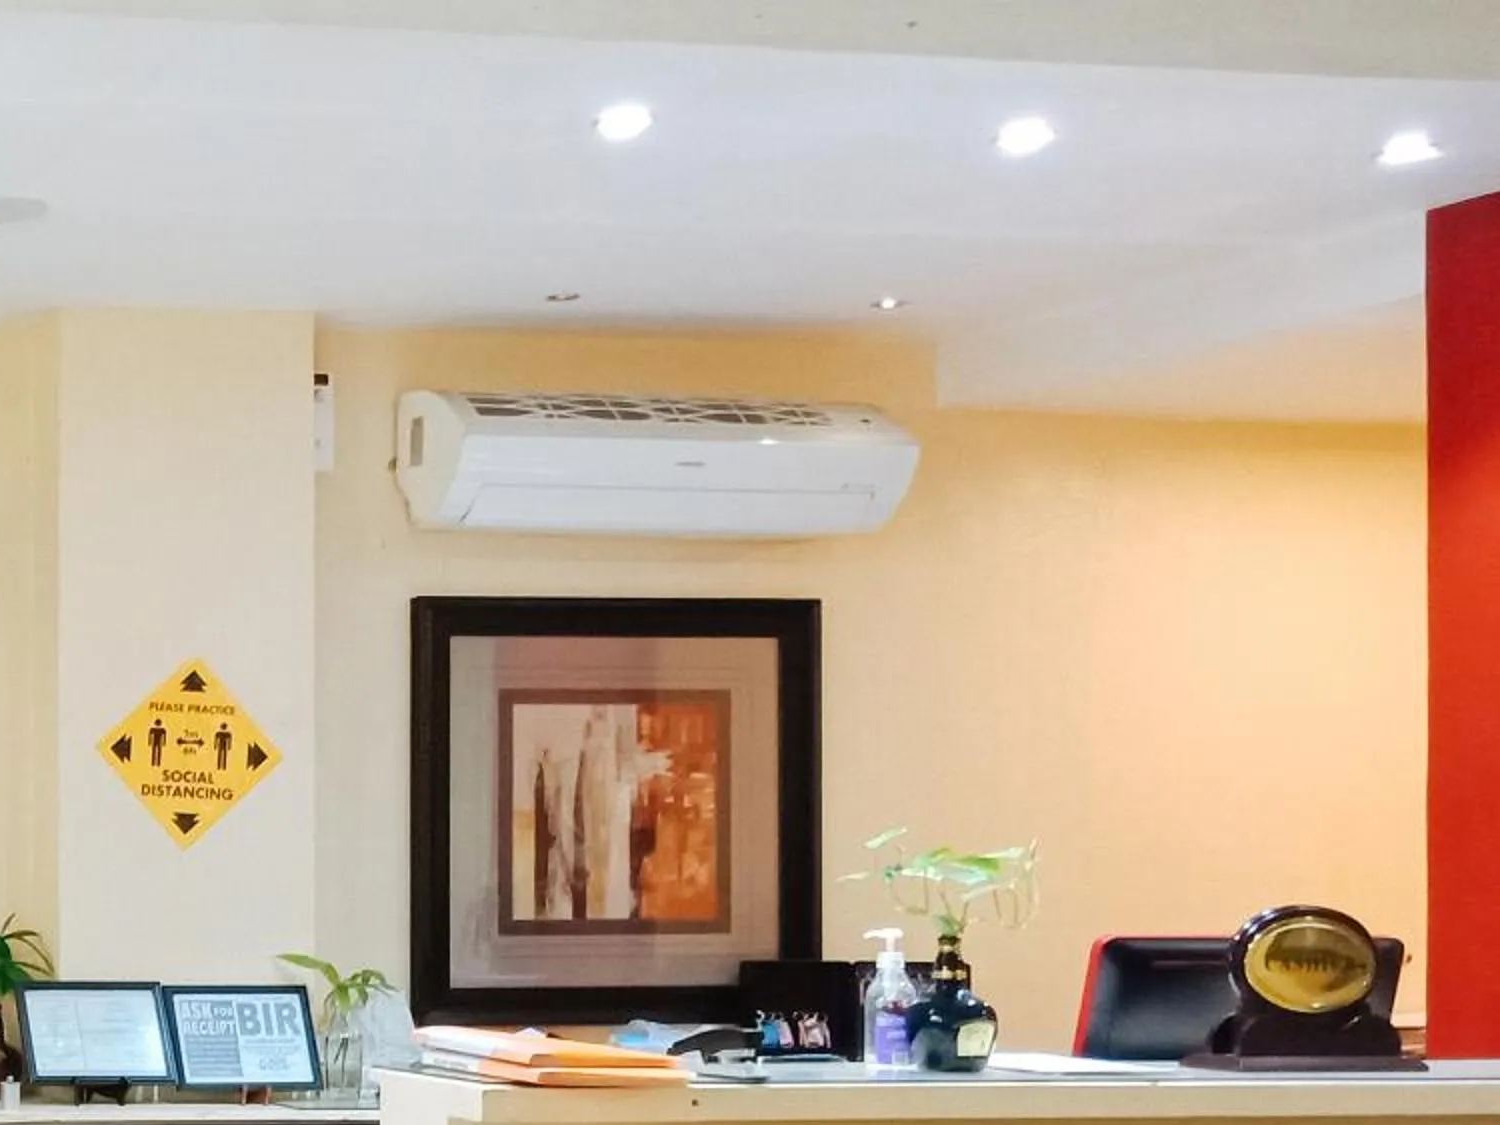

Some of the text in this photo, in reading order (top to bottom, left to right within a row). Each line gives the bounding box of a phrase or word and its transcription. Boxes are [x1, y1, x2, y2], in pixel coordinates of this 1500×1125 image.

[149, 702, 235, 715] PLEASE PRACTICE
[162, 769, 214, 784] SOCIAL
[141, 784, 234, 801] DISTANCING
[181, 1001, 213, 1019] ASK
[236, 1002, 301, 1036] BIR
[183, 1020, 236, 1036] RECEIPT
